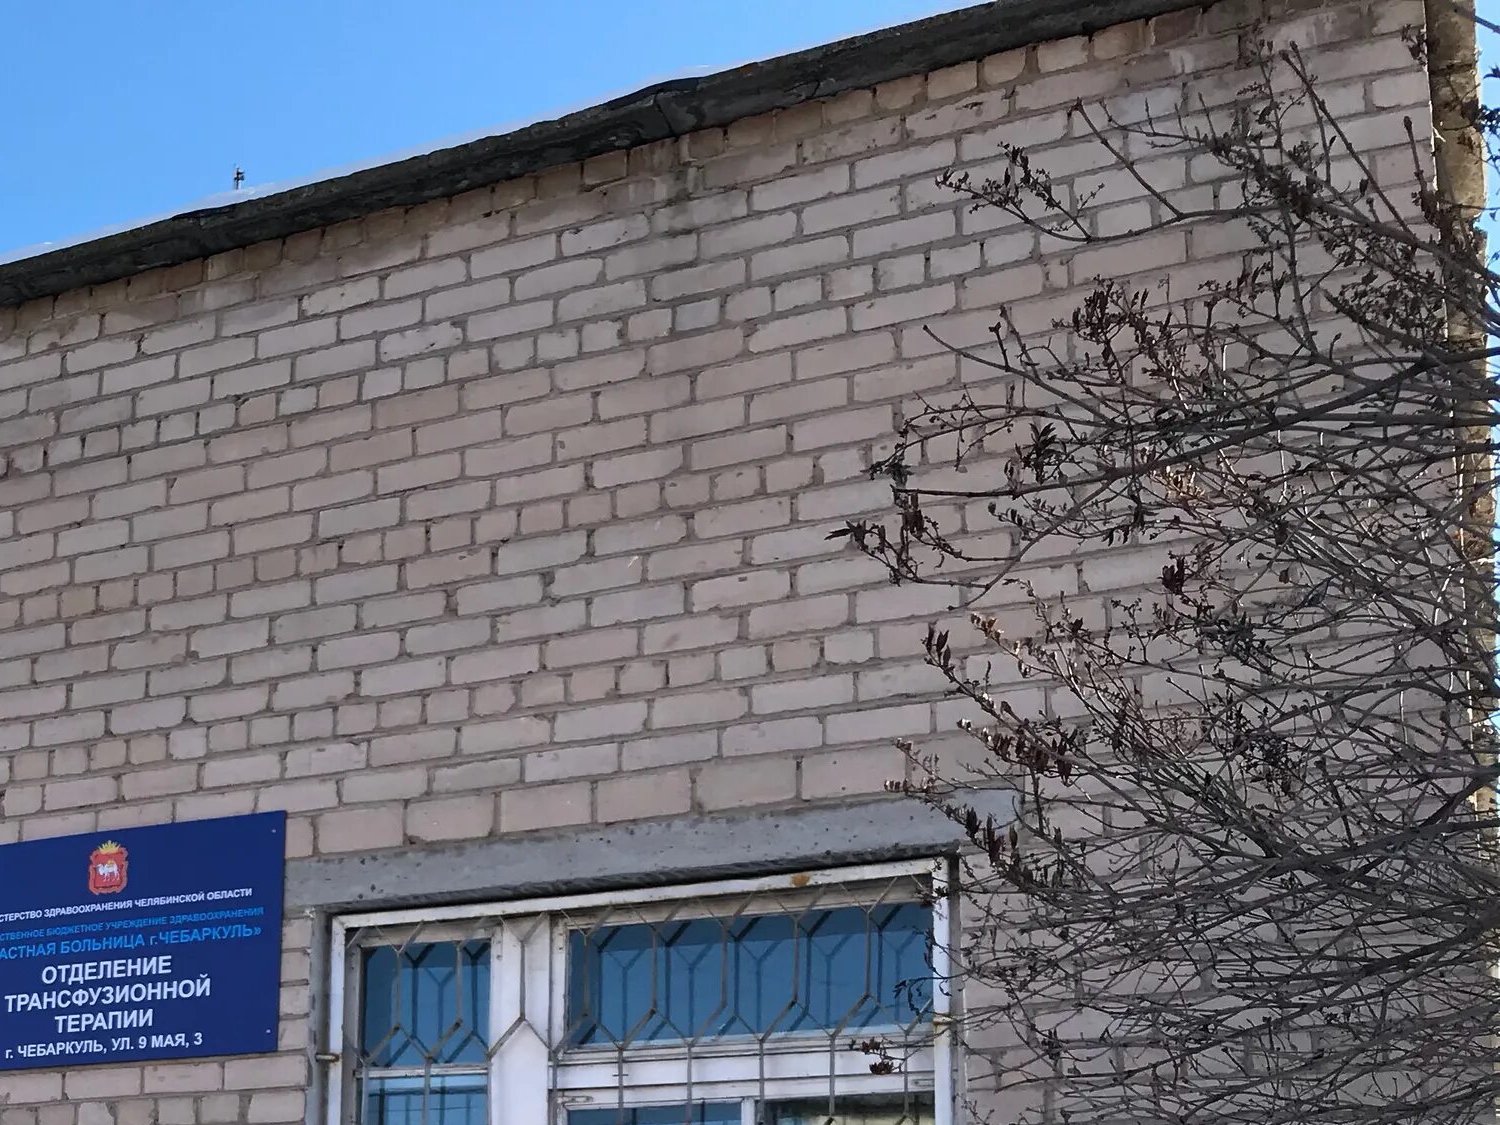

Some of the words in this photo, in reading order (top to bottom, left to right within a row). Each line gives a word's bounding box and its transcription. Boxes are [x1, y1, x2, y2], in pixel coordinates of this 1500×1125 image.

[44, 900, 133, 918] ЗДРАВООХРАНЕНИЯ
[135, 892, 205, 907] ЧЕЛЯБИНСКОЙ
[207, 888, 252, 901] ОБЛАСТИ
[46, 923, 104, 936] БЮДЖЕТНОЕ
[106, 916, 167, 930] УЧРЕЖДЕНИЕ
[169, 907, 264, 924] ЗДРАВООХРАНЕНИЯ
[60, 934, 145, 954] БОЛЬНИЦА
[41, 955, 172, 985] ОТДЕЛЕНИЕ
[4, 973, 211, 1012] ТРАНСФУЗИОННОЙ
[54, 1008, 153, 1033] ТЕРАПИИ
[5, 1049, 14, 1059] г.
[17, 1039, 107, 1058] ЧЕБАРКУЛЬ,
[111, 1037, 135, 1052] УЛ.
[138, 1036, 147, 1049] 9
[151, 1033, 190, 1049] МАЯ,
[193, 1032, 203, 1045] 3
